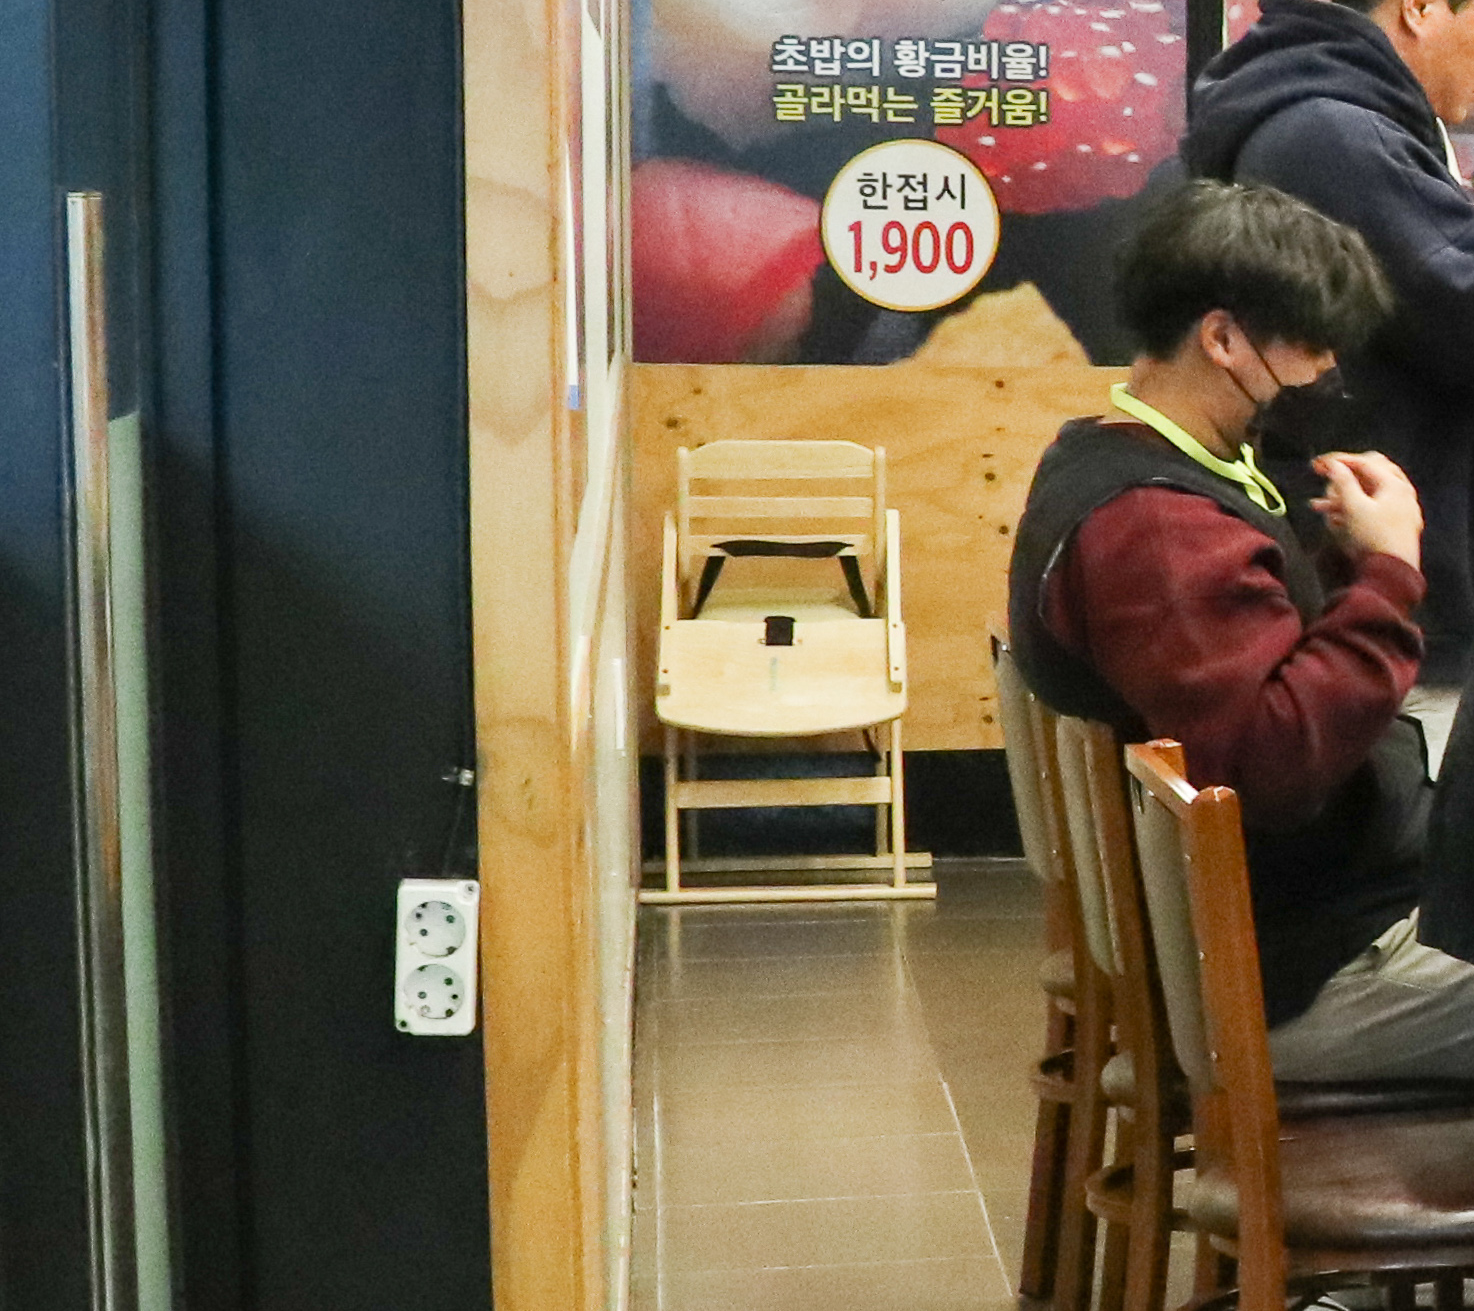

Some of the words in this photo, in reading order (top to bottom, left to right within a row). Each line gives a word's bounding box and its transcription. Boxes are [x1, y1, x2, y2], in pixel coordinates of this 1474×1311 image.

[772, 36, 881, 77] 초밥의
[894, 39, 1049, 81] 황금비율!
[772, 83, 919, 124] 골라먹는
[930, 86, 1049, 126] 즐거움!
[856, 171, 967, 211] 한접시
[848, 220, 975, 281] 1,900
